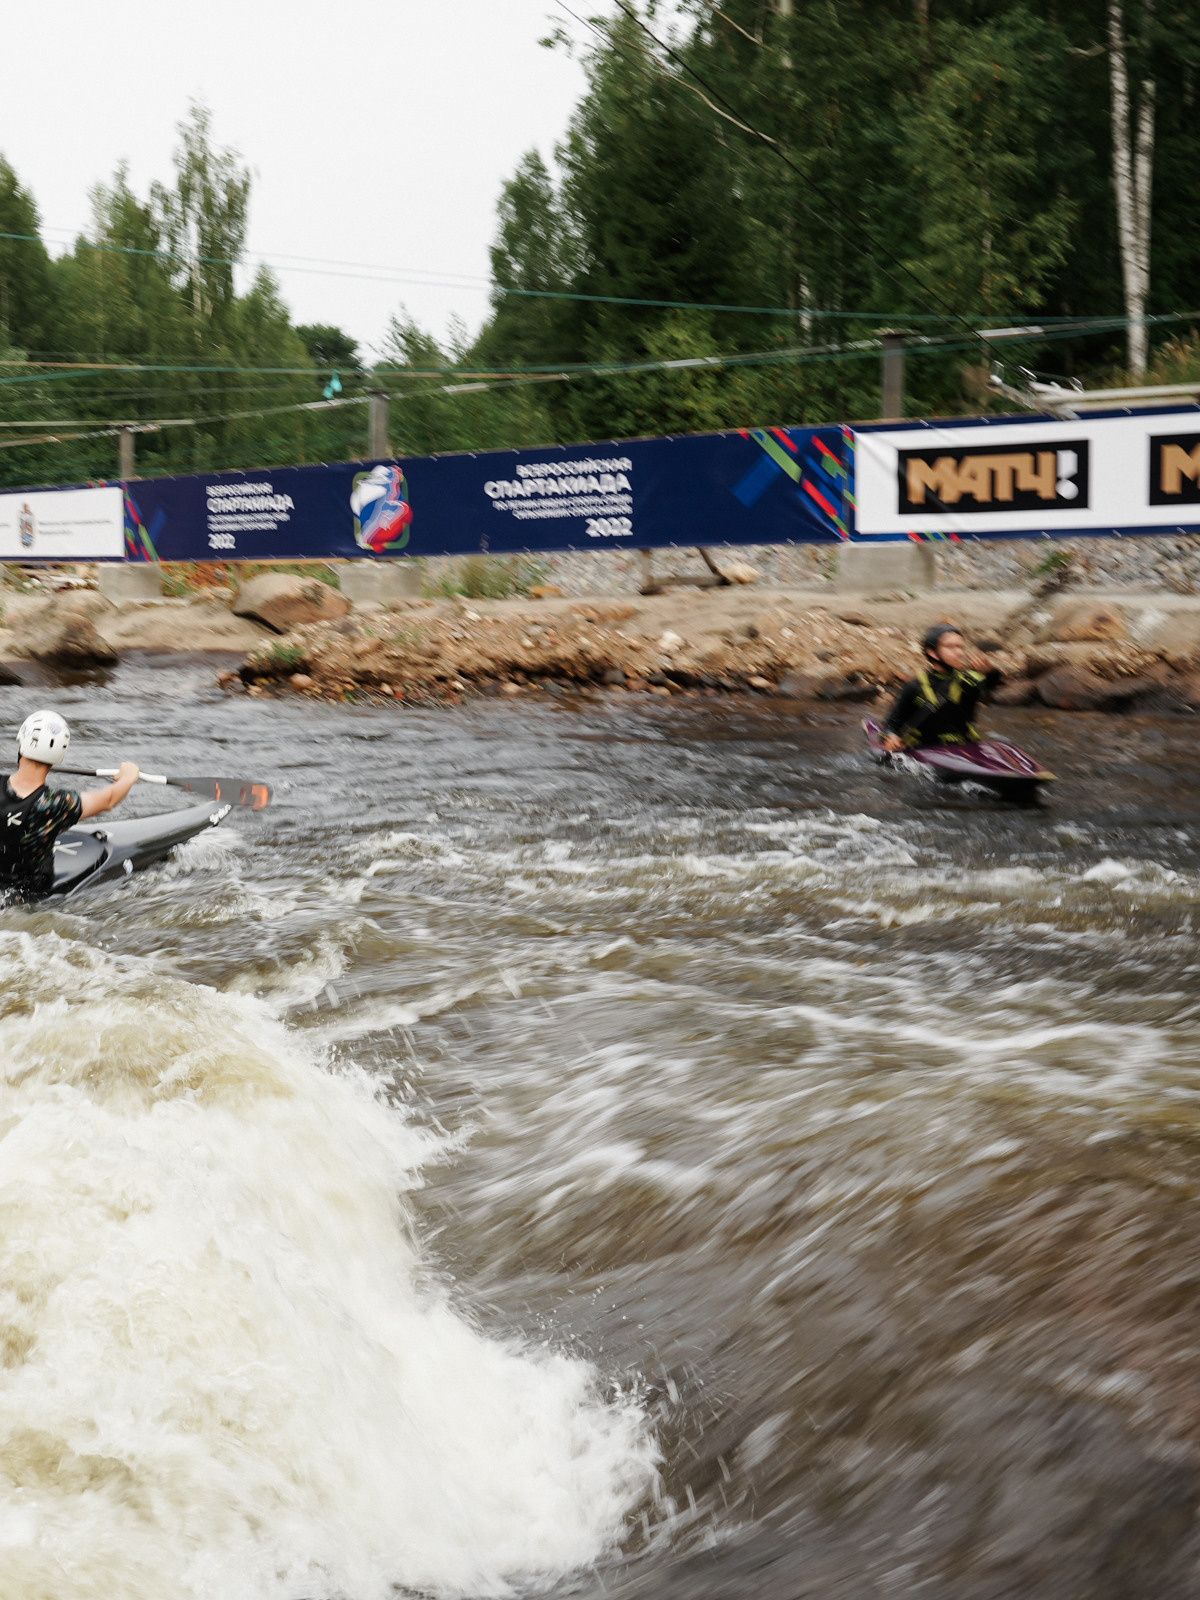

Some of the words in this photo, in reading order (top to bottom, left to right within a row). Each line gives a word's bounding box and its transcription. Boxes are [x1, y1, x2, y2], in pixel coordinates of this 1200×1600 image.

[516, 457, 632, 478] ВСЕРОССИЙСКАЯ
[906, 450, 1079, 504] МАТЧ!
[484, 473, 633, 499] СПАРТАКИАДА
[585, 516, 633, 537] 2022
